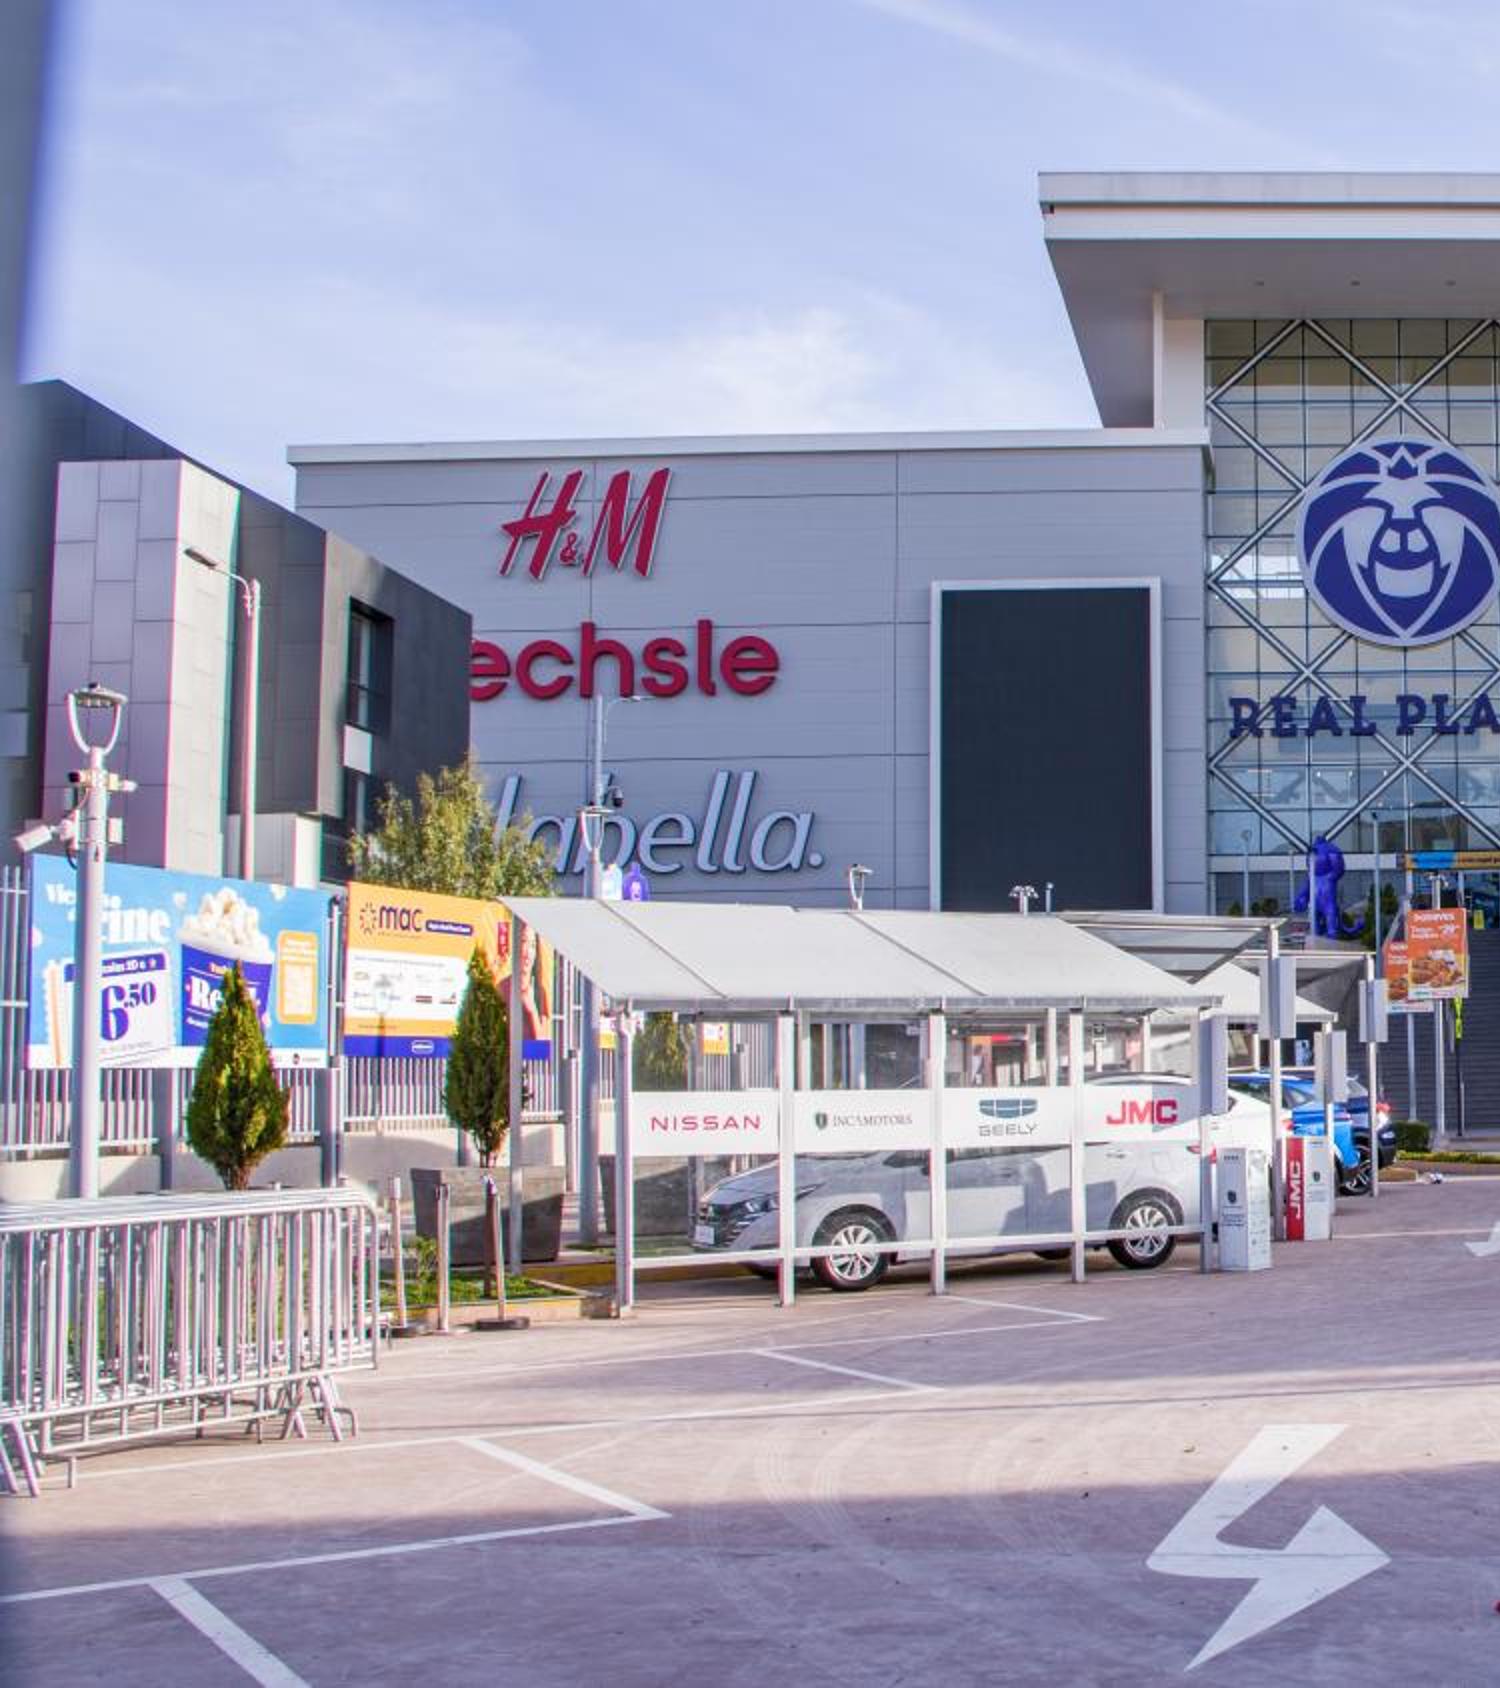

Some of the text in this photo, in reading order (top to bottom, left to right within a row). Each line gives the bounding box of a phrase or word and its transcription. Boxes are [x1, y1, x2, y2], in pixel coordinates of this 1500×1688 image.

[499, 467, 672, 581] H&M
[1228, 694, 1377, 739] REAL
[378, 904, 423, 933] mac
[651, 1114, 761, 1132] NISSAN
[832, 1112, 913, 1128] INCAMOTORS
[1106, 1099, 1179, 1125] JMC
[978, 1122, 1038, 1137] GEELY
[1289, 1160, 1302, 1220] JMC
